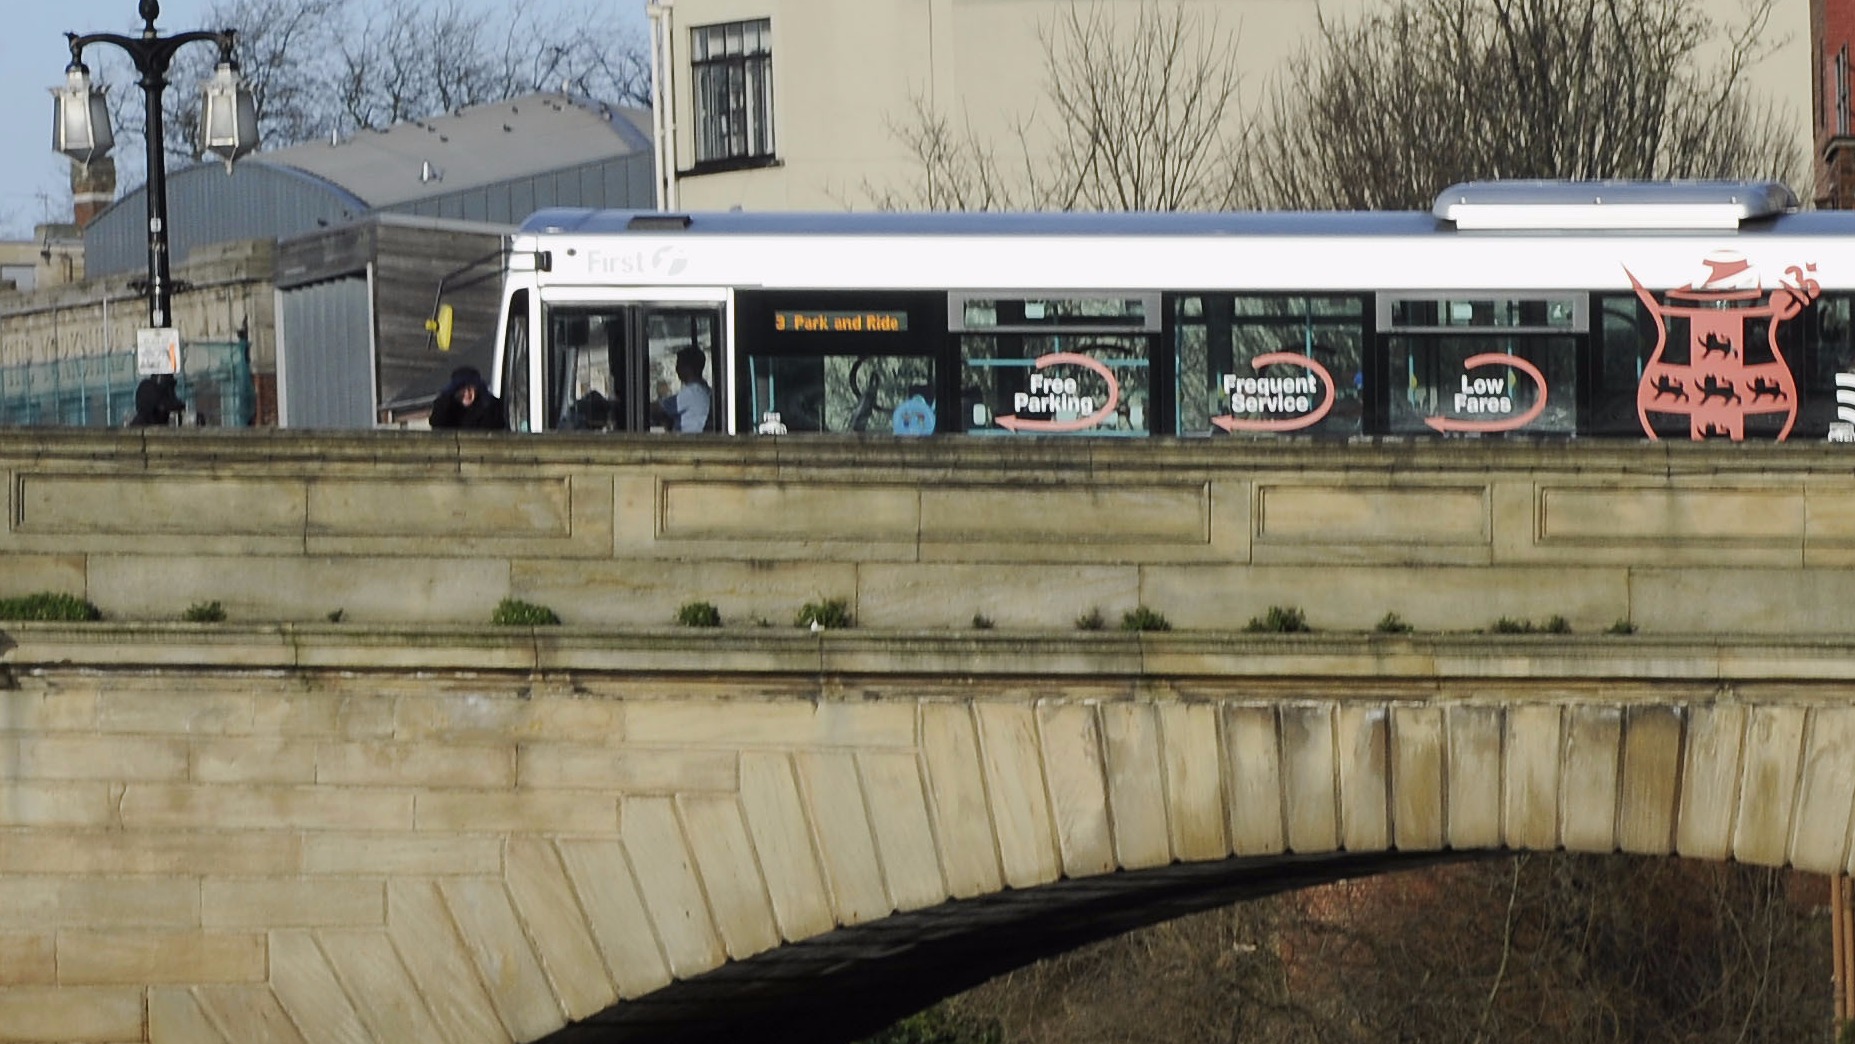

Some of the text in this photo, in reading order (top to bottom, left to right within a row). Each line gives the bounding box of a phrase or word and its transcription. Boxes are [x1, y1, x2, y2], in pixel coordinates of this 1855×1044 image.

[586, 251, 645, 273] First
[775, 314, 899, 331] 3 Park and Ride
[1030, 373, 1077, 395] Free
[1223, 373, 1317, 397] Frequent
[1461, 374, 1504, 395] Low
[1014, 392, 1093, 417] Parking
[1231, 392, 1309, 413] Service
[1454, 392, 1512, 414] Fares
